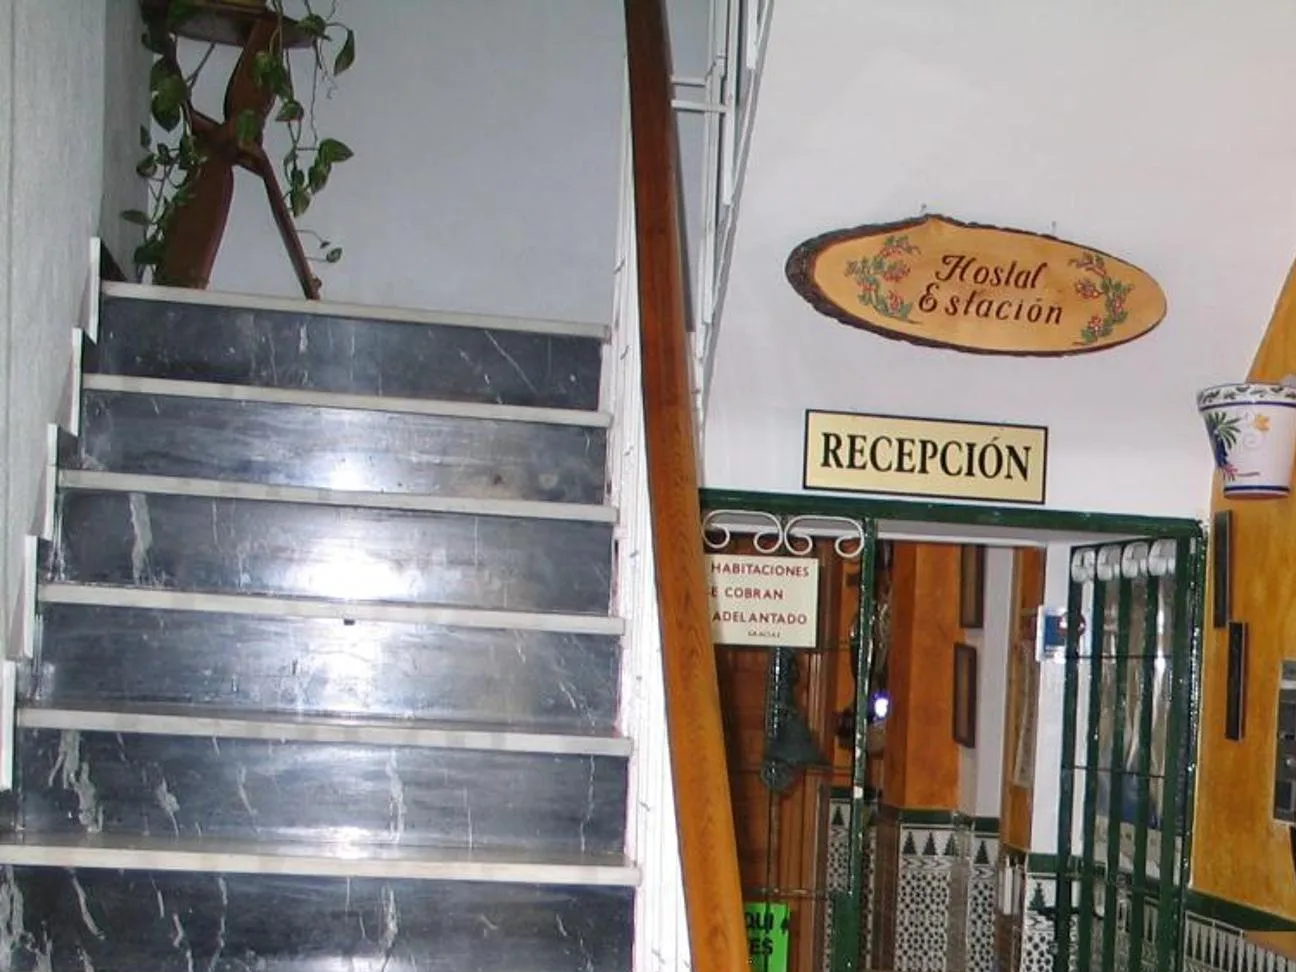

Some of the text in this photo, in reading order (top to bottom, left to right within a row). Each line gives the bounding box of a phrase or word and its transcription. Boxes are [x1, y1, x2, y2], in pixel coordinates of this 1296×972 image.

[934, 253, 1049, 290] Hostal
[917, 282, 1064, 326] Estación
[819, 431, 1033, 482] RECEPCIÓN
[710, 561, 810, 578] HABITACIONES
[724, 586, 784, 601] COBRAN
[711, 611, 808, 625] ADELANTADO
